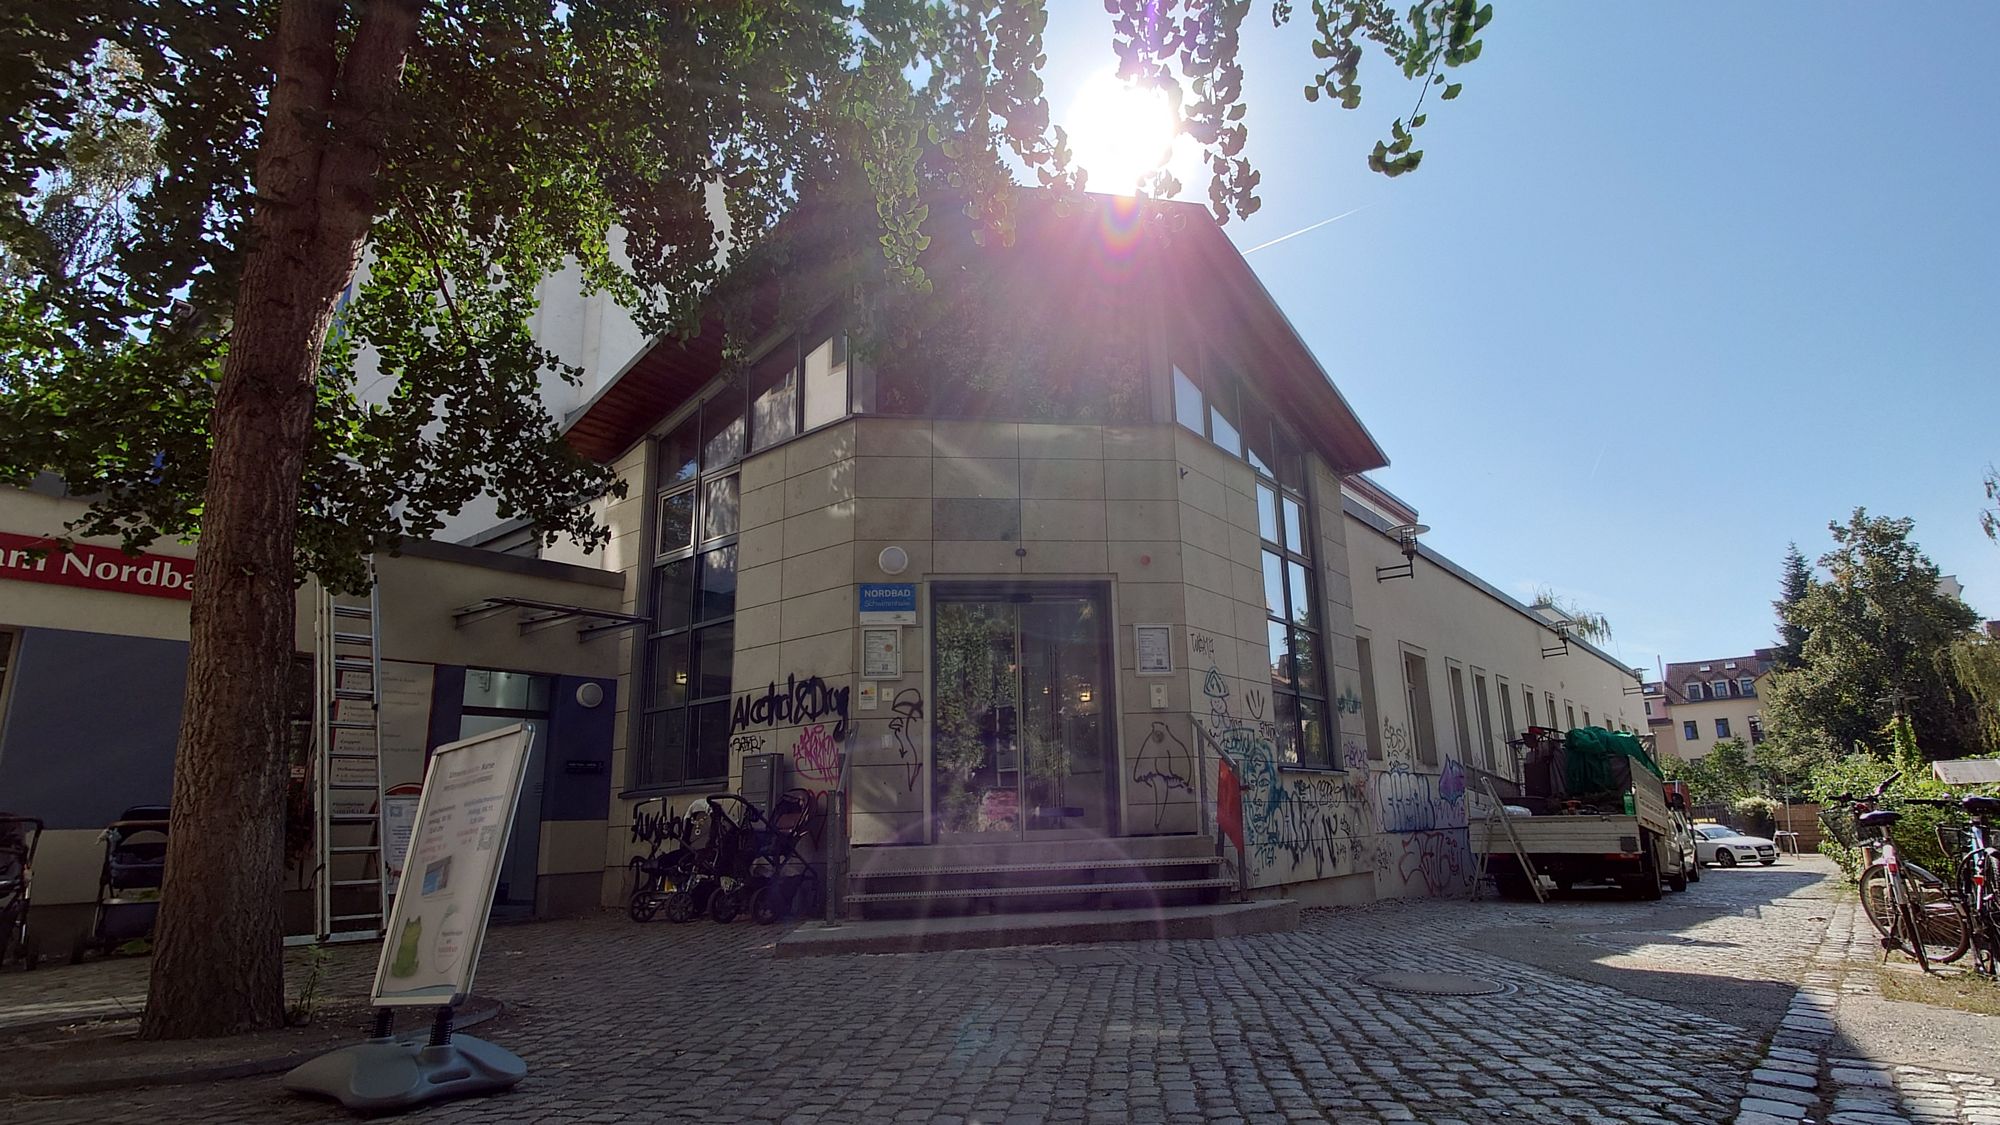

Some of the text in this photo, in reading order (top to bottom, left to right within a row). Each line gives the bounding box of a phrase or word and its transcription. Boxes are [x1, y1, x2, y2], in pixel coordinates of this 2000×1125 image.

[0, 548, 195, 591] m Nordba
[864, 588, 911, 598] NORDBAD
